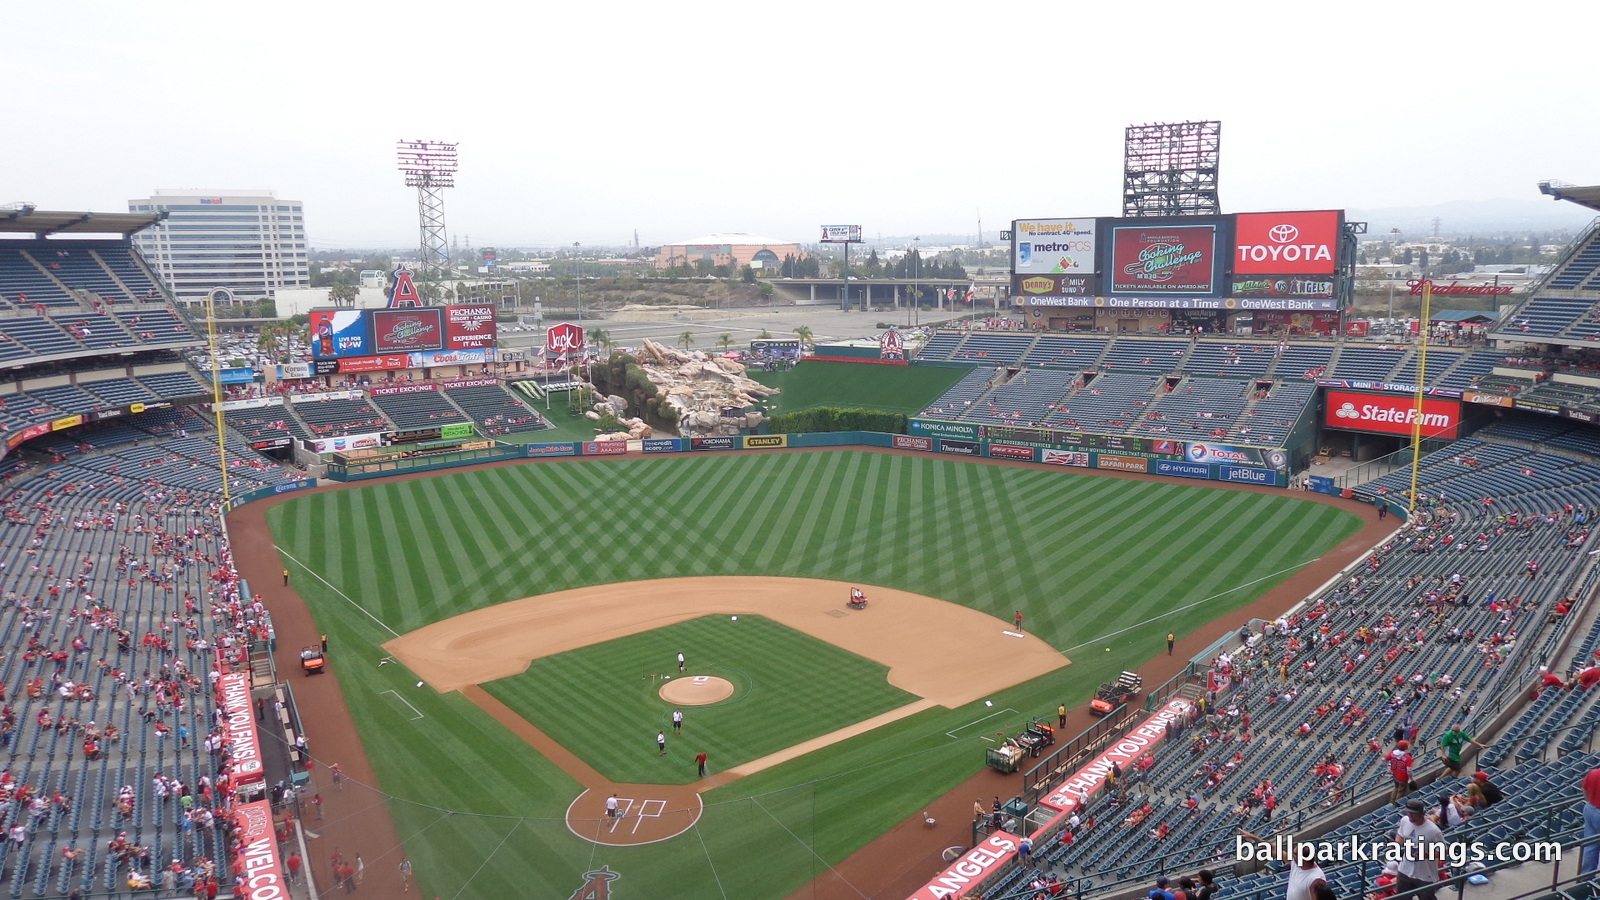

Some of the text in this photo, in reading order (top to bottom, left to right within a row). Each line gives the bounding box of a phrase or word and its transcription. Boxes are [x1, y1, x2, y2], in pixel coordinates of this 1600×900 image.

[1019, 221, 1076, 232] We have it.
[1034, 240, 1092, 252] metroPCS
[1138, 243, 1185, 262] Cooking
[1237, 244, 1332, 262] TOYOTA
[1144, 251, 1202, 272] Challenge
[1024, 280, 1052, 290] Denny's
[1406, 279, 1514, 297] Budweiser
[1030, 296, 1089, 306] OneWest Bank
[1109, 299, 1130, 307] One
[1132, 299, 1166, 307] Person
[1191, 299, 1219, 308] Time
[1241, 299, 1314, 309] OneWest Bank
[450, 307, 492, 315] PECHANGA
[392, 320, 423, 332] Cooking
[397, 324, 434, 339] Challenge
[452, 334, 493, 342] EXPERIENCE
[550, 327, 582, 350] Jack
[339, 341, 362, 349] NOW
[458, 353, 481, 361] LIGHT
[284, 365, 308, 373] Corona
[400, 384, 433, 393] EXCHANGE
[467, 379, 497, 387] EXCHANGE
[1383, 384, 1420, 392] STORAGE
[1569, 410, 1591, 421] Yard House
[920, 423, 974, 434] KONICA MINOLTA
[1210, 448, 1248, 460] TOTAL
[1100, 460, 1145, 470] SAFARI PARK
[1172, 465, 1208, 474] HYUNDAI
[1228, 467, 1266, 480] jetBlue
[275, 483, 297, 493] Corona
[224, 679, 249, 711] THANK
[227, 708, 251, 731] YOU
[230, 729, 256, 762] FANS!
[1058, 709, 1178, 796] THANK YOU FANS!
[244, 836, 285, 900] WELCO
[927, 836, 1017, 900] ANGELS
